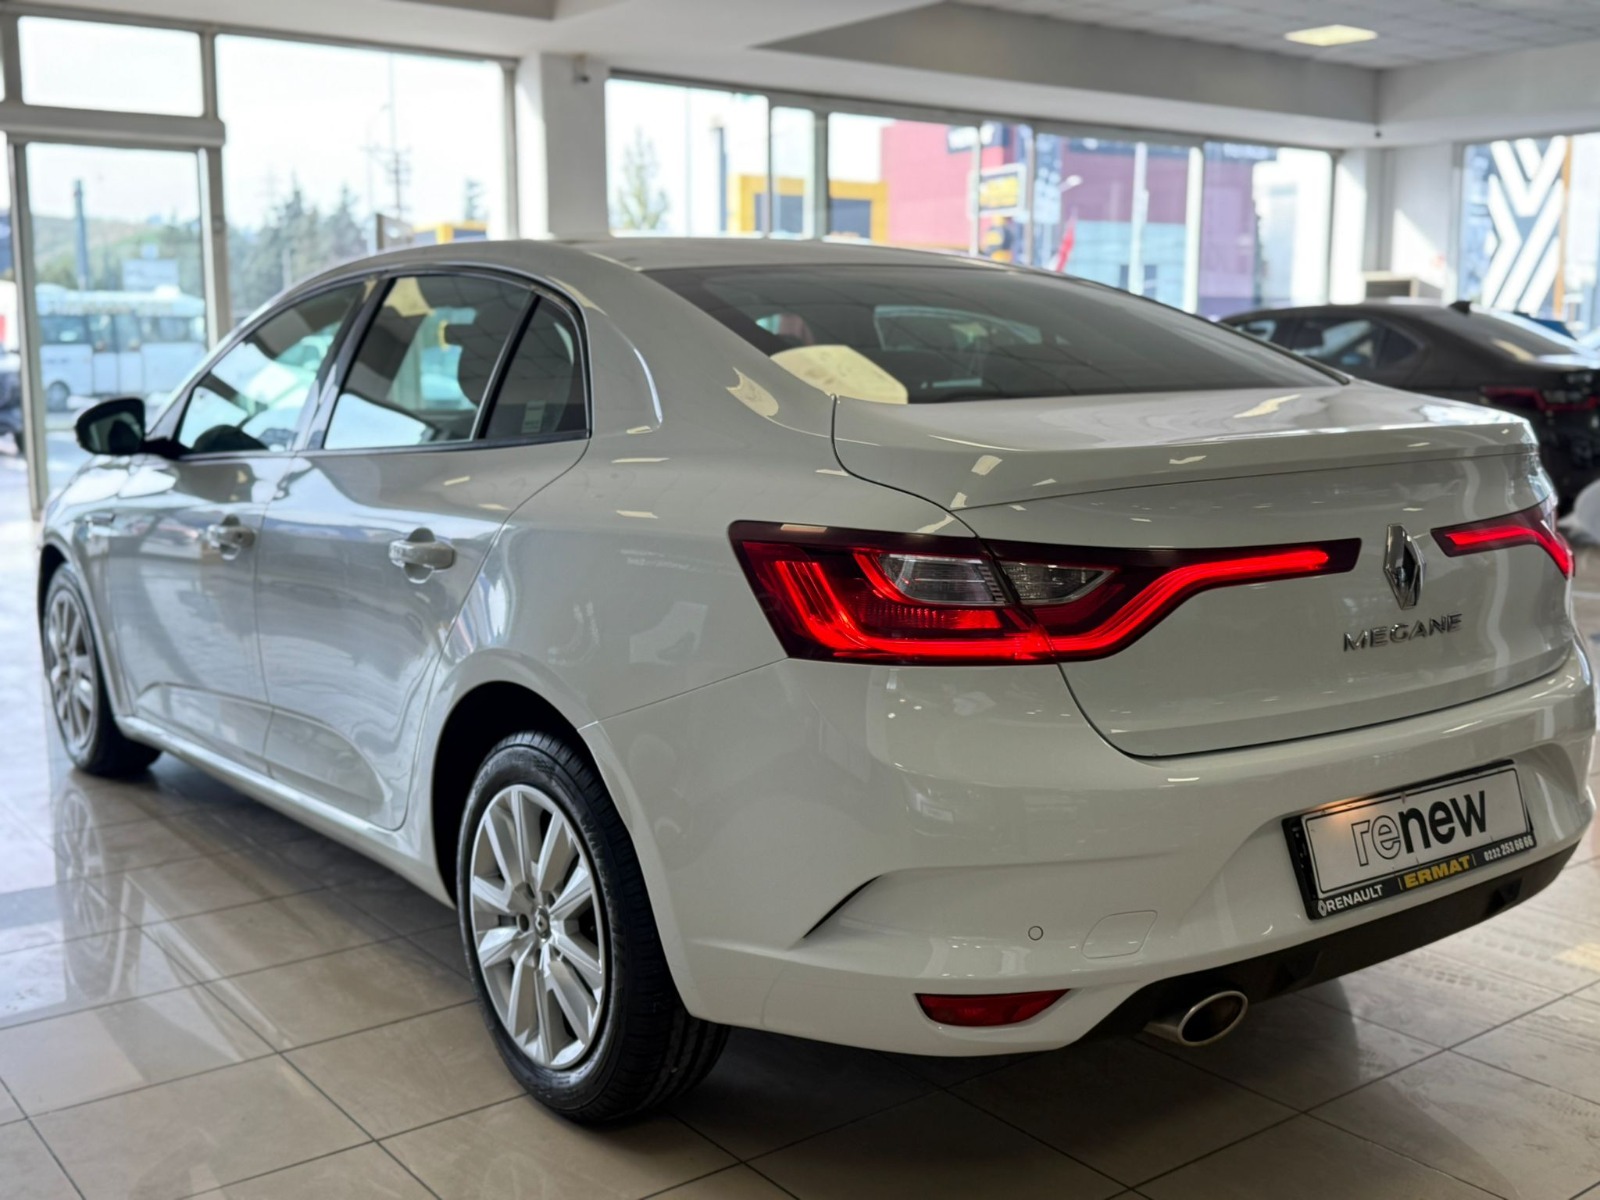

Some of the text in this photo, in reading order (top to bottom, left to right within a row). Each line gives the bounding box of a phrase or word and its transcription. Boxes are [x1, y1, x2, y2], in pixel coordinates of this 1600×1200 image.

[1343, 613, 1462, 652] MEGANE
[1351, 790, 1486, 867] renew
[1326, 884, 1383, 912] RENAULT
[1404, 854, 1470, 889] ERMAT
